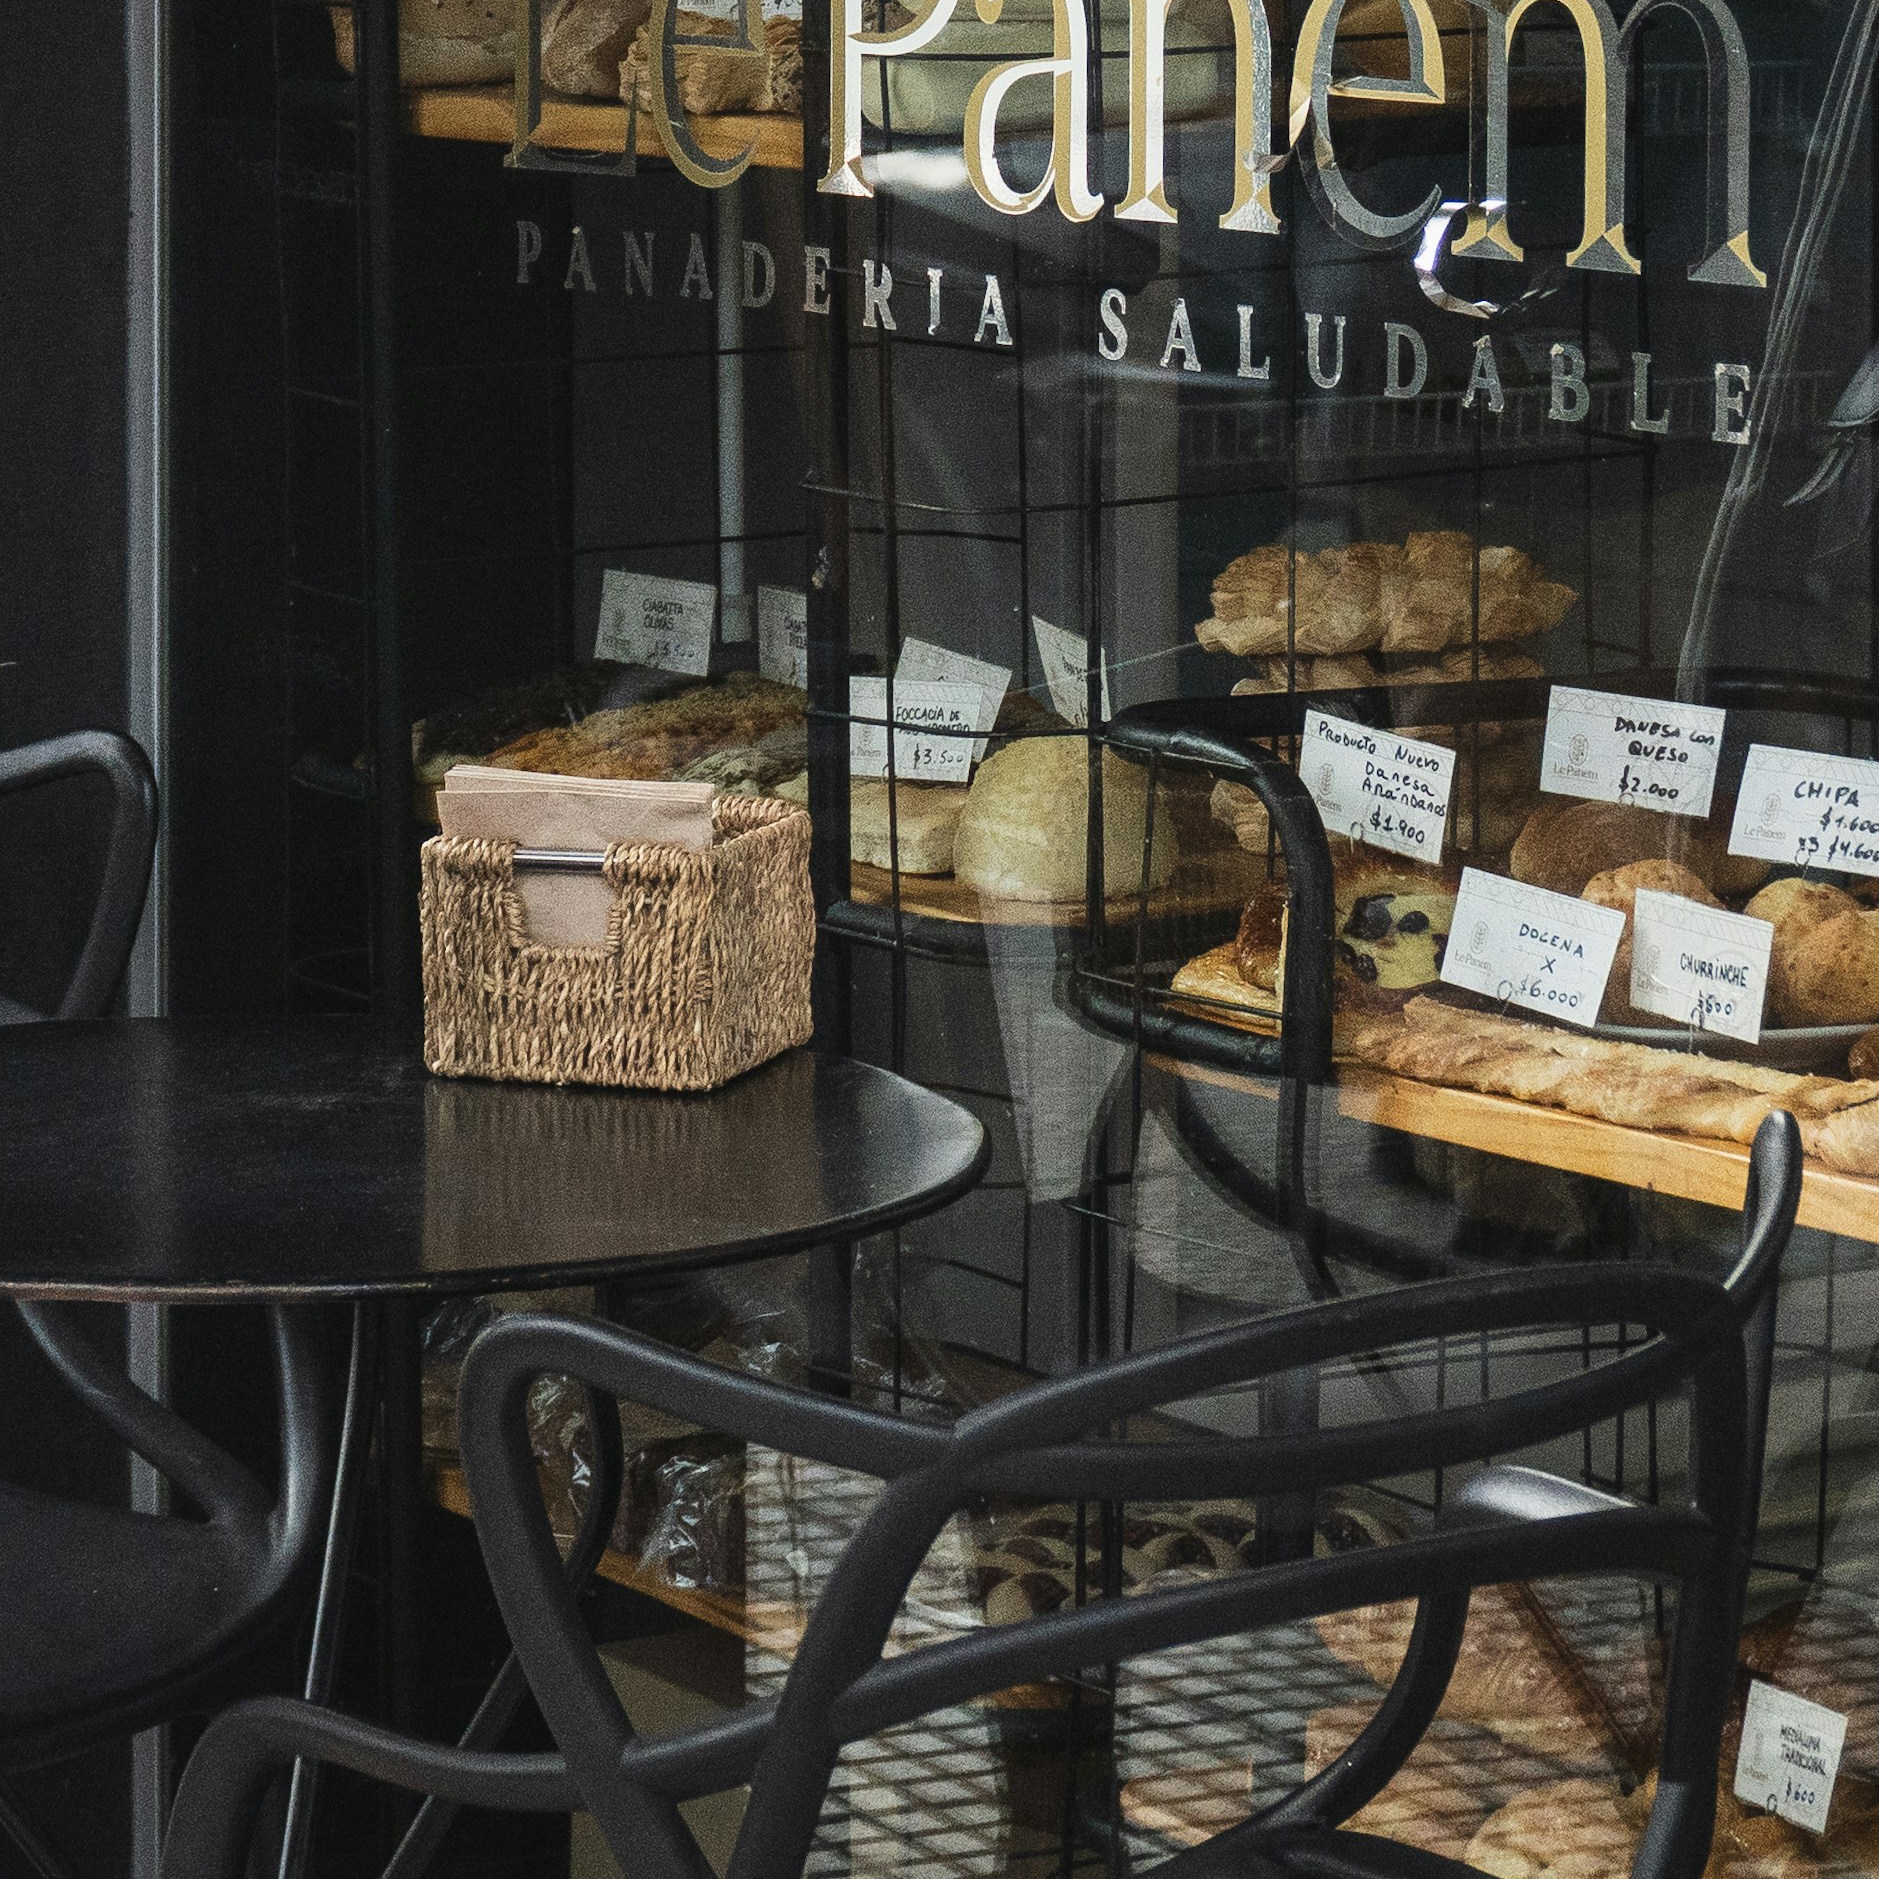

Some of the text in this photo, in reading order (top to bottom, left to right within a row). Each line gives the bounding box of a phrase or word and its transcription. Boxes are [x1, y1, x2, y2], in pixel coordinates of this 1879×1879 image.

[515, 218, 1753, 446] PANADERIA SALUDABLE
[1627, 739, 1689, 764] QUESO
[1365, 760, 1435, 797] Danesa
[1794, 779, 1860, 809] CHIPA
[1519, 922, 1584, 959] DOCENA
